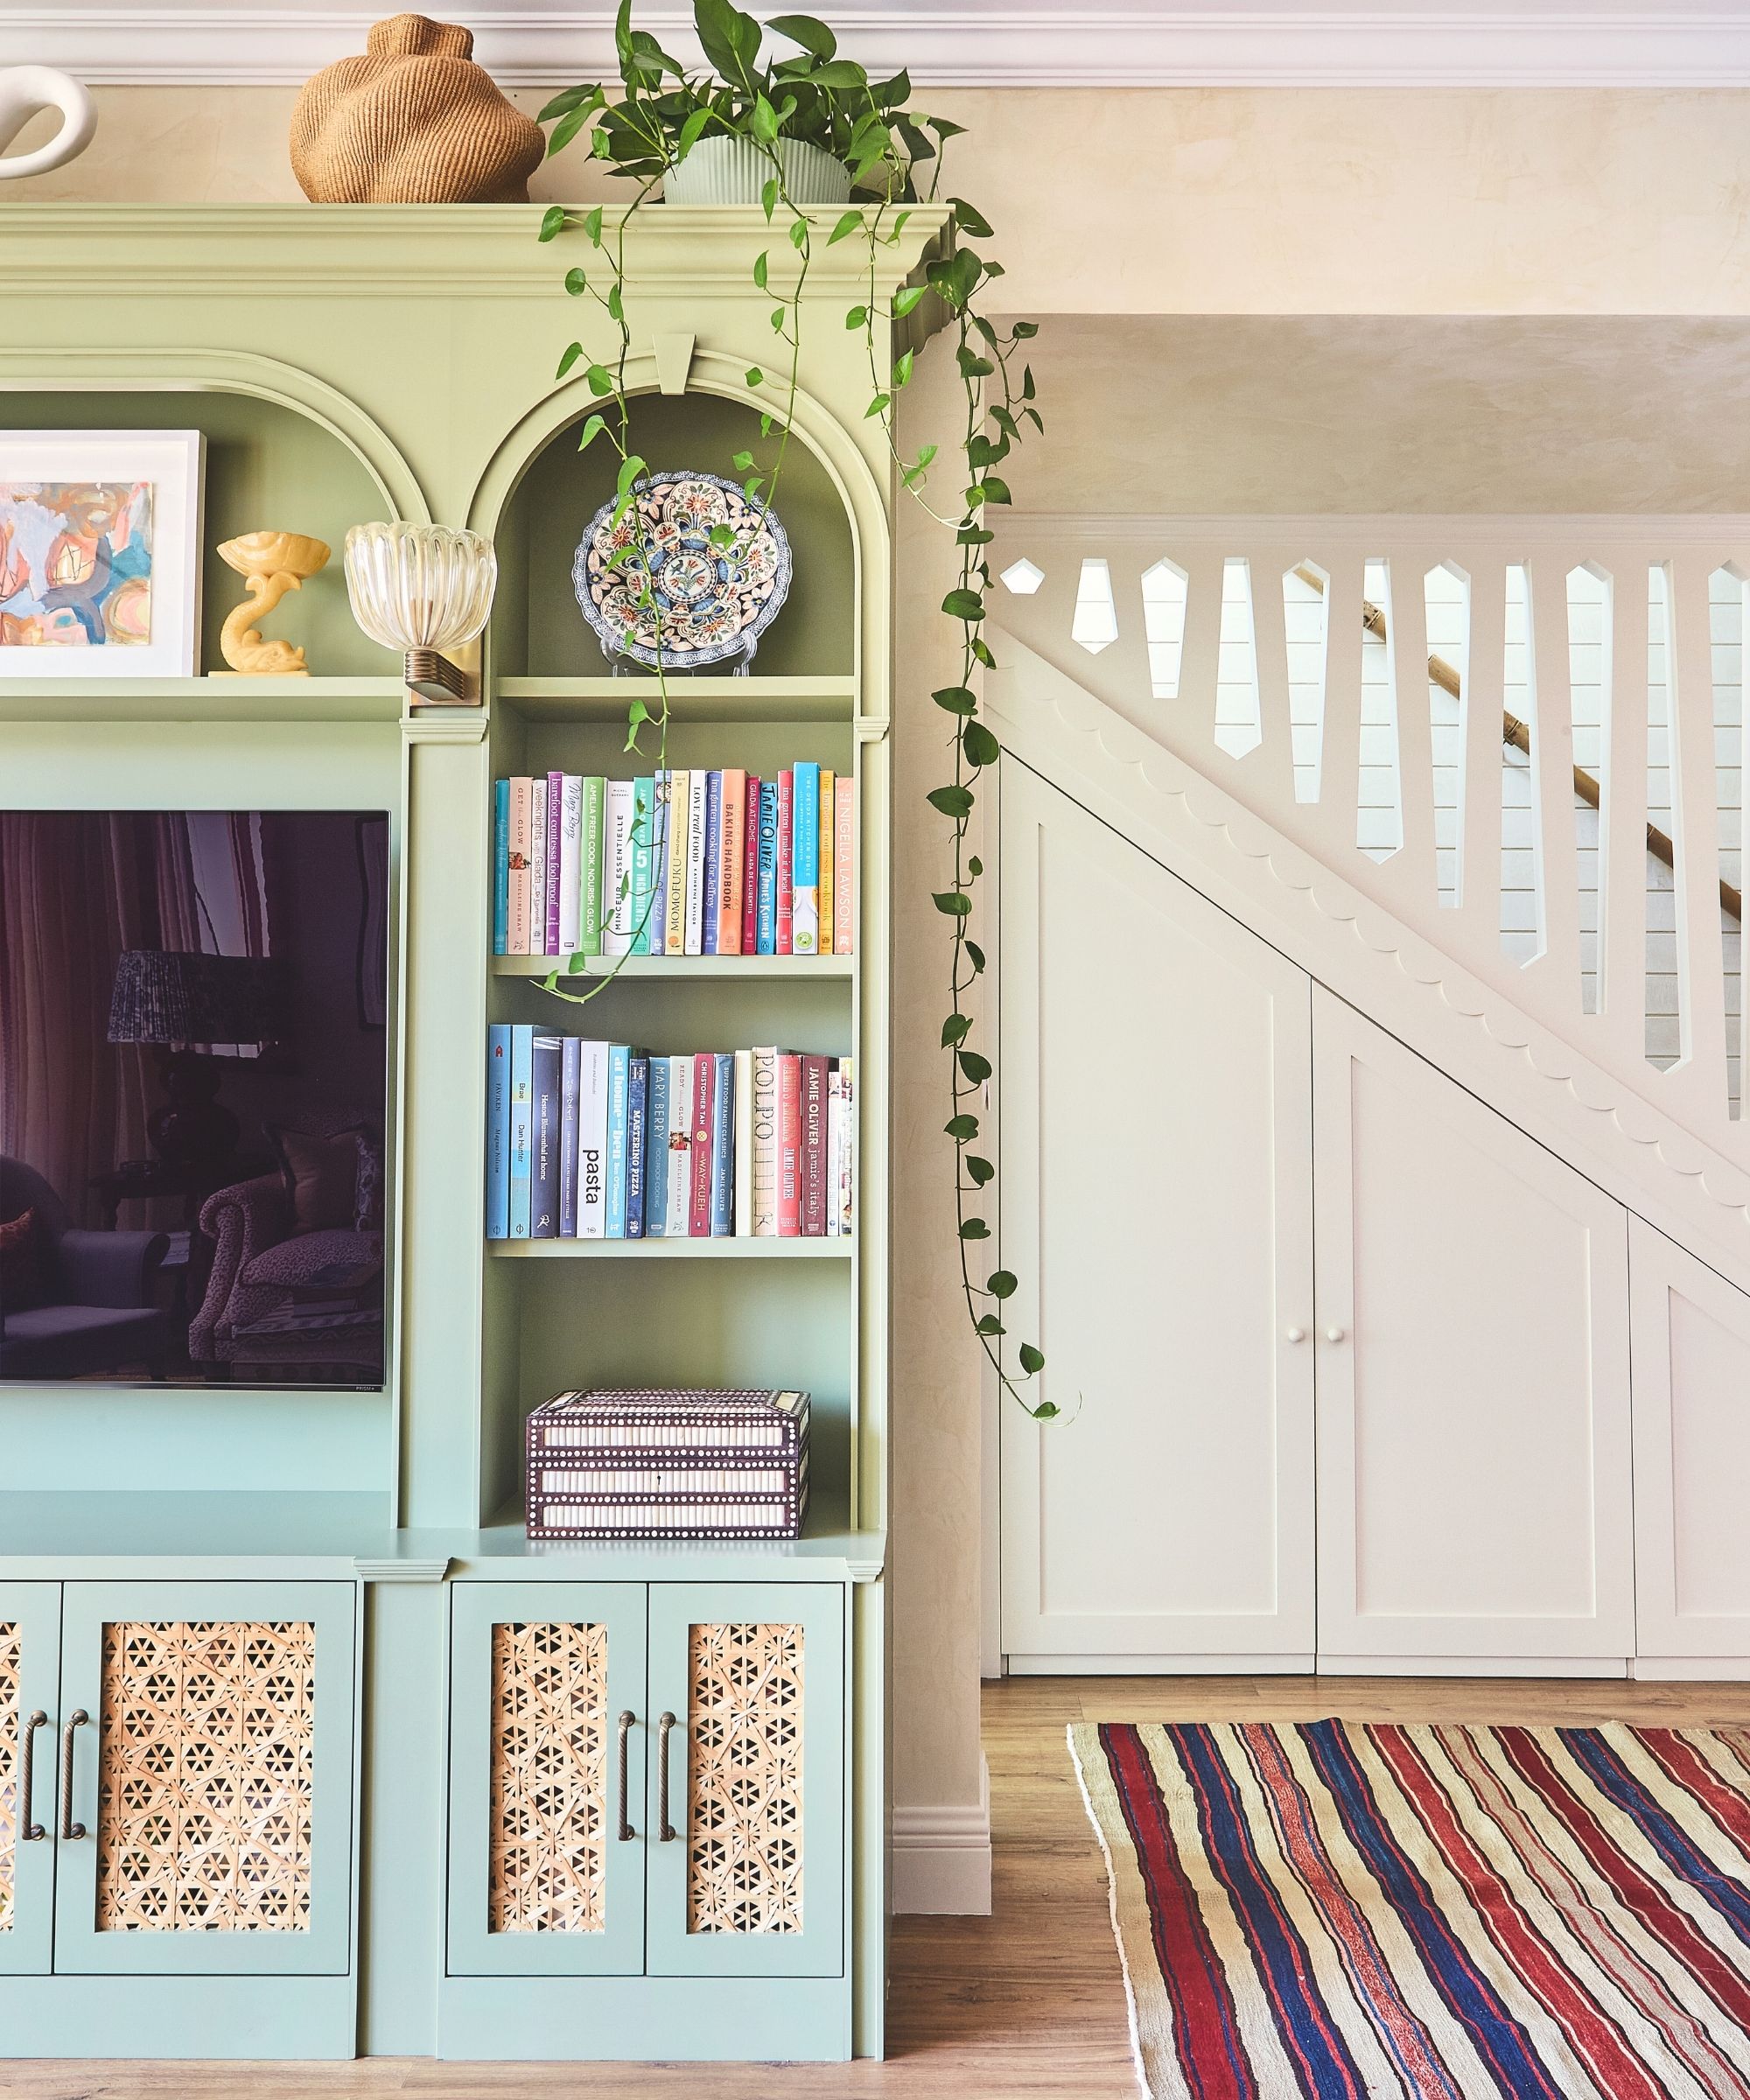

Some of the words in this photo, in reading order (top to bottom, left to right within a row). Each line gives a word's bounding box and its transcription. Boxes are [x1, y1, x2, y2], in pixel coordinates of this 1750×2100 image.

[550, 778, 561, 817] barefoot
[563, 783, 581, 815] Mary
[588, 784, 597, 816] AMELIA
[710, 779, 719, 793] ina
[782, 787, 792, 801] ina
[822, 775, 831, 793] the
[534, 787, 543, 841] weeknights
[709, 794, 718, 822] garten
[748, 808, 756, 818] AT
[761, 785, 776, 824] JAMIE
[779, 802, 789, 830] garten
[822, 794, 832, 831] barefoot
[550, 819, 560, 860] contessa
[563, 812, 580, 841] Berry
[588, 816, 597, 840] FREER
[692, 814, 703, 834] real
[724, 803, 734, 846] BAKING
[733, 804, 742, 849] MARTHA
[747, 818, 756, 843] HOME
[838, 807, 851, 863] NIGELLA
[587, 841, 596, 868] COOK.
[615, 815, 624, 879] ESSENTIELLE
[636, 850, 648, 868] 5
[706, 827, 718, 864] cooking
[760, 826, 775, 870] OLIVER
[781, 835, 791, 858] make
[822, 834, 831, 873] contessa
[534, 856, 543, 884] Giada
[547, 862, 560, 907] foolproof
[708, 864, 718, 877] for
[723, 849, 733, 910] HANDBOOK
[732, 851, 741, 911] STEWART'S
[748, 871, 754, 879] DE
[781, 868, 792, 893] ahead
[586, 868, 596, 908] NOURISH.
[670, 858, 682, 931] MOMOFUKU
[705, 878, 717, 908] Jeffrey
[822, 875, 832, 921] cookbook
[838, 867, 851, 928] LAWSON
[586, 907, 595, 936] GLOW.
[613, 1056, 625, 1073] at
[613, 1075, 625, 1118] home
[654, 1066, 666, 1099] MARY
[699, 1060, 708, 1110] CHRISTOPHER
[753, 1054, 775, 1140] POLPO
[808, 1067, 820, 1101] JAMIE
[540, 1093, 549, 1117] Heston
[540, 1118, 549, 1156] Blumenthal
[653, 1103, 665, 1140] BERRY
[612, 1129, 624, 1159] ben
[631, 1110, 641, 1166] MASTERING
[539, 1162, 549, 1181] home
[697, 1158, 707, 1179] WAY
[782, 1146, 795, 1171] JAMIE
[807, 1148, 821, 1188] jamie's
[841, 1148, 851, 1173] family
[582, 1149, 601, 1205] pasta
[630, 1167, 640, 1197] PIZZA
[782, 1172, 795, 1200] OLIVER
[696, 1184, 706, 1211] KUEH
[807, 1190, 821, 1217] italy
